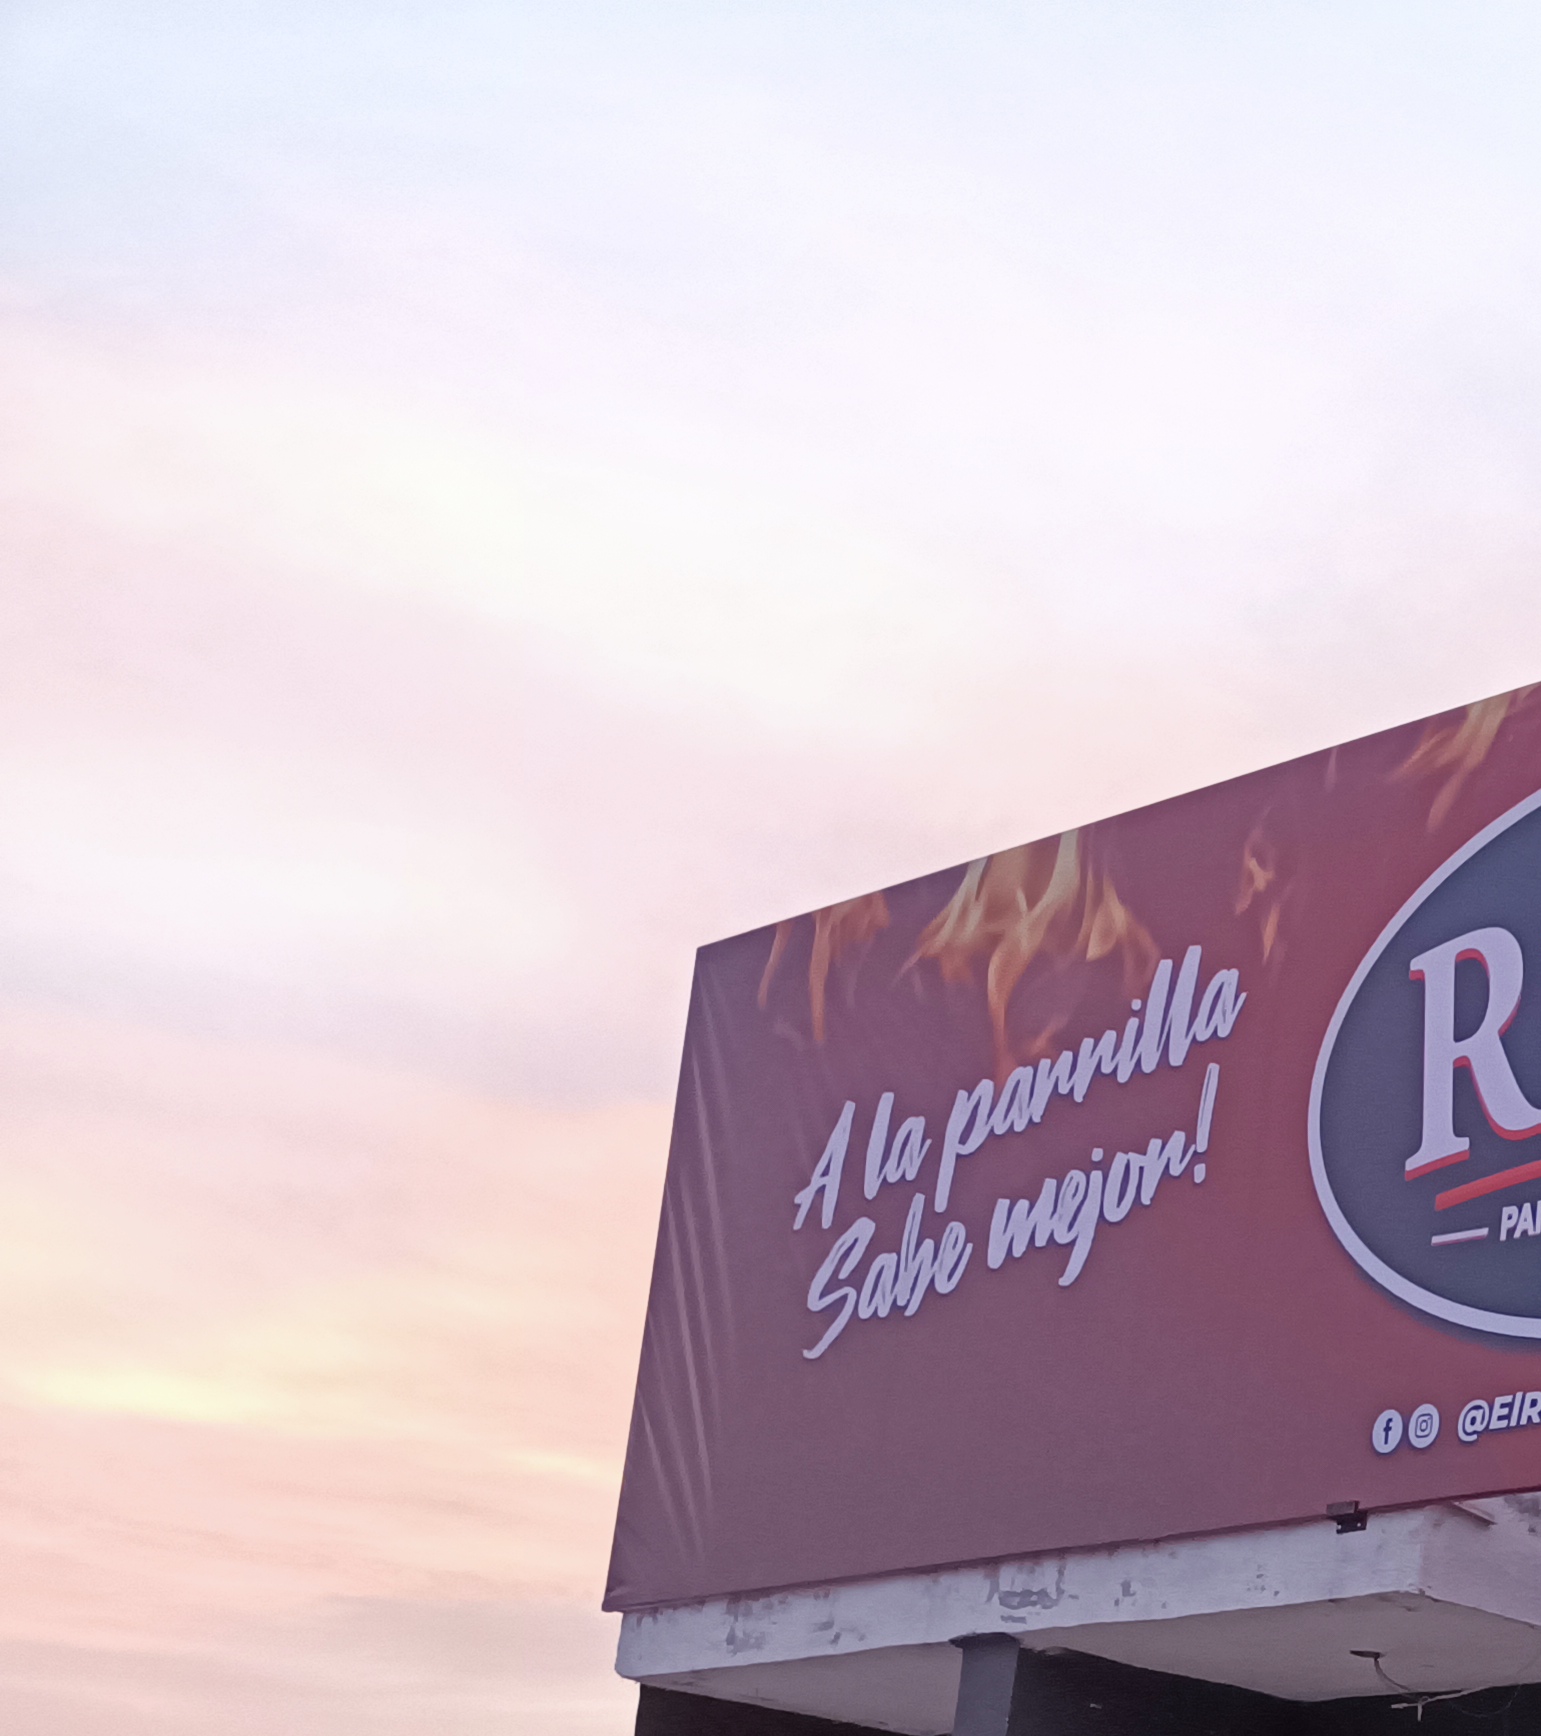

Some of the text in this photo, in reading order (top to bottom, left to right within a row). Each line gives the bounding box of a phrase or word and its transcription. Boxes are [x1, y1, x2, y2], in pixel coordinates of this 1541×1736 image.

[793, 944, 1249, 1230] A la parrilla
[802, 1062, 1220, 1359] Sabe mejor!
